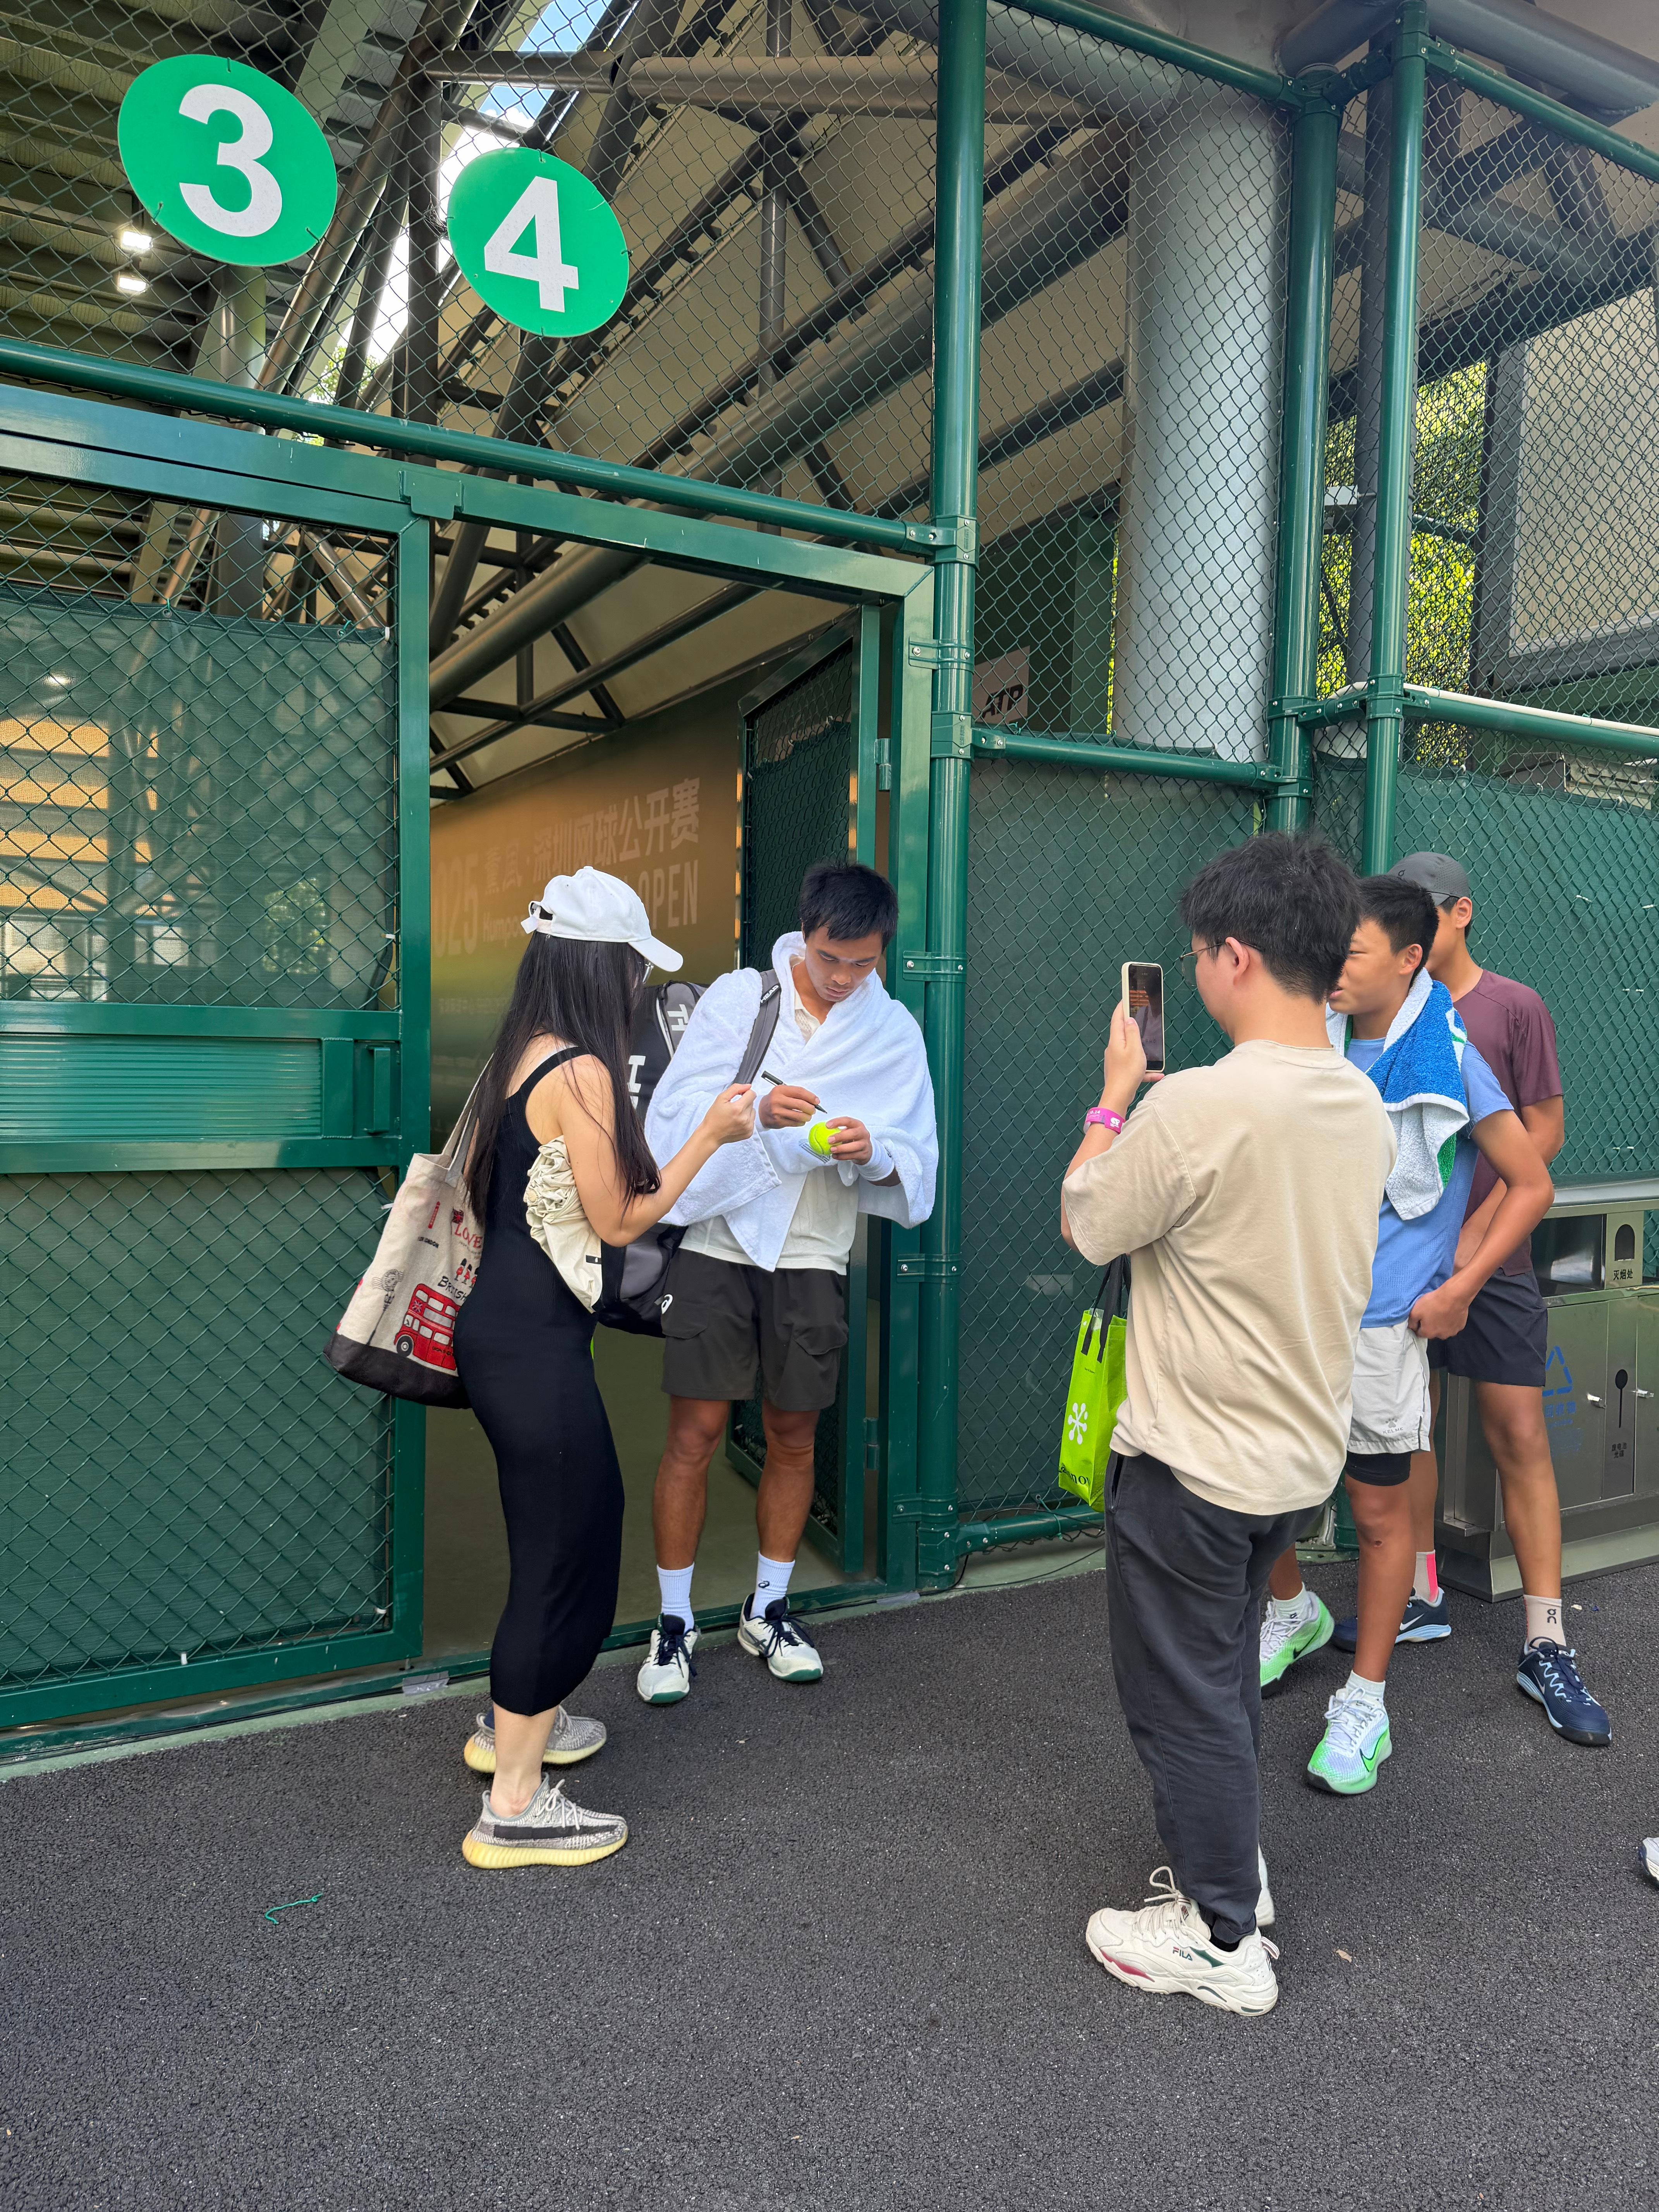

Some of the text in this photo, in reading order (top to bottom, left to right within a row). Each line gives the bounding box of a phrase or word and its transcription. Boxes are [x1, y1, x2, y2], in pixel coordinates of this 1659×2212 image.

[179, 84, 282, 237] 3
[484, 176, 579, 313] 4
[979, 684, 1025, 719] ATP
[638, 859, 699, 930] OPEN
[455, 1223, 483, 1249] LOVE
[1613, 1268, 1633, 1281] 灭烟处
[1173, 1946, 1193, 1961] FILA
